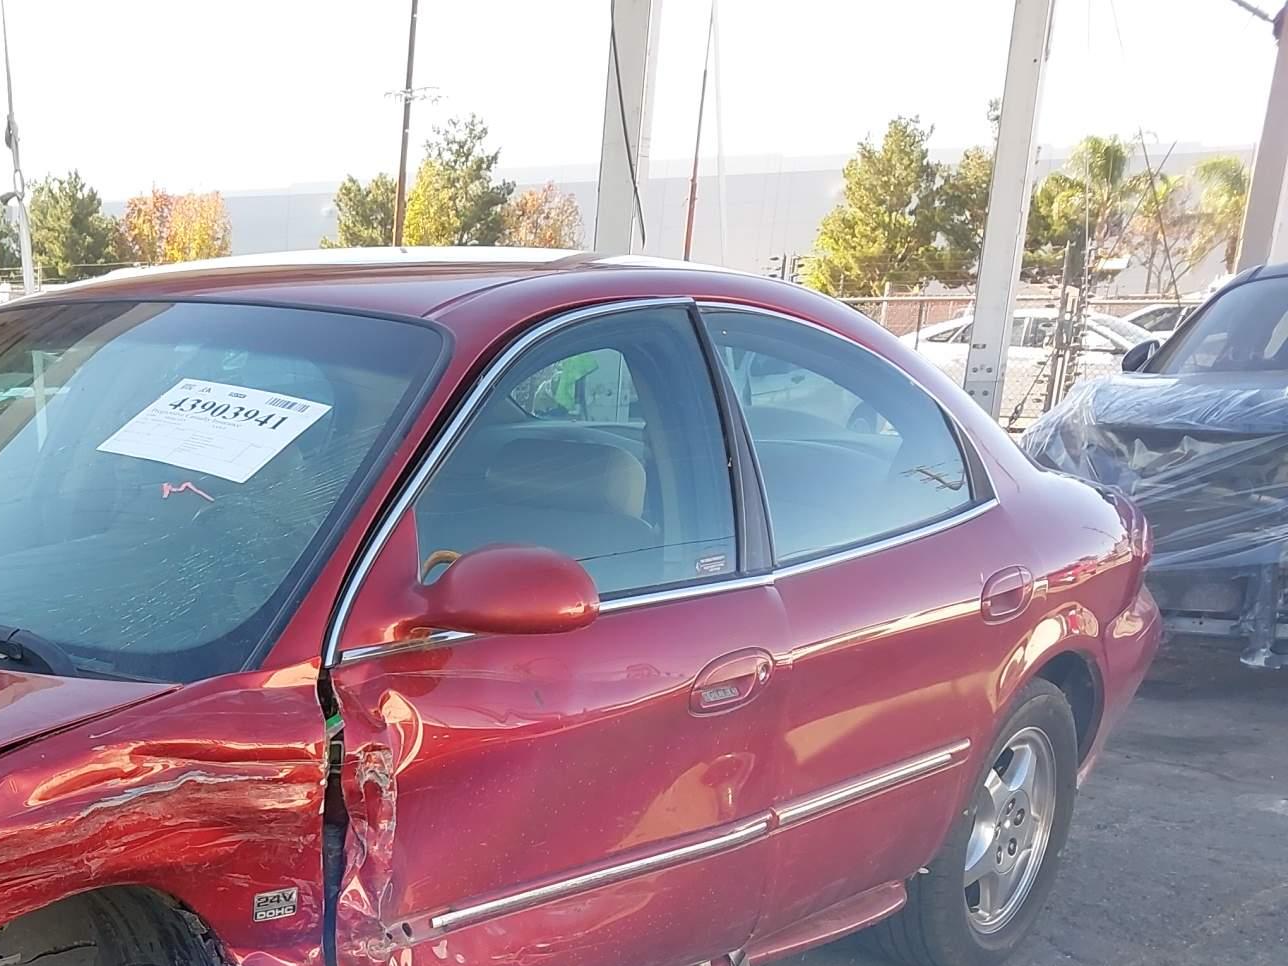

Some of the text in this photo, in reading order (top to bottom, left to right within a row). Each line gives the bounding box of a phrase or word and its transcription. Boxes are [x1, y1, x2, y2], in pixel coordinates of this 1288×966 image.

[168, 397, 289, 430] 43903941
[256, 891, 295, 908] 24V
[256, 905, 295, 920] DOHC
